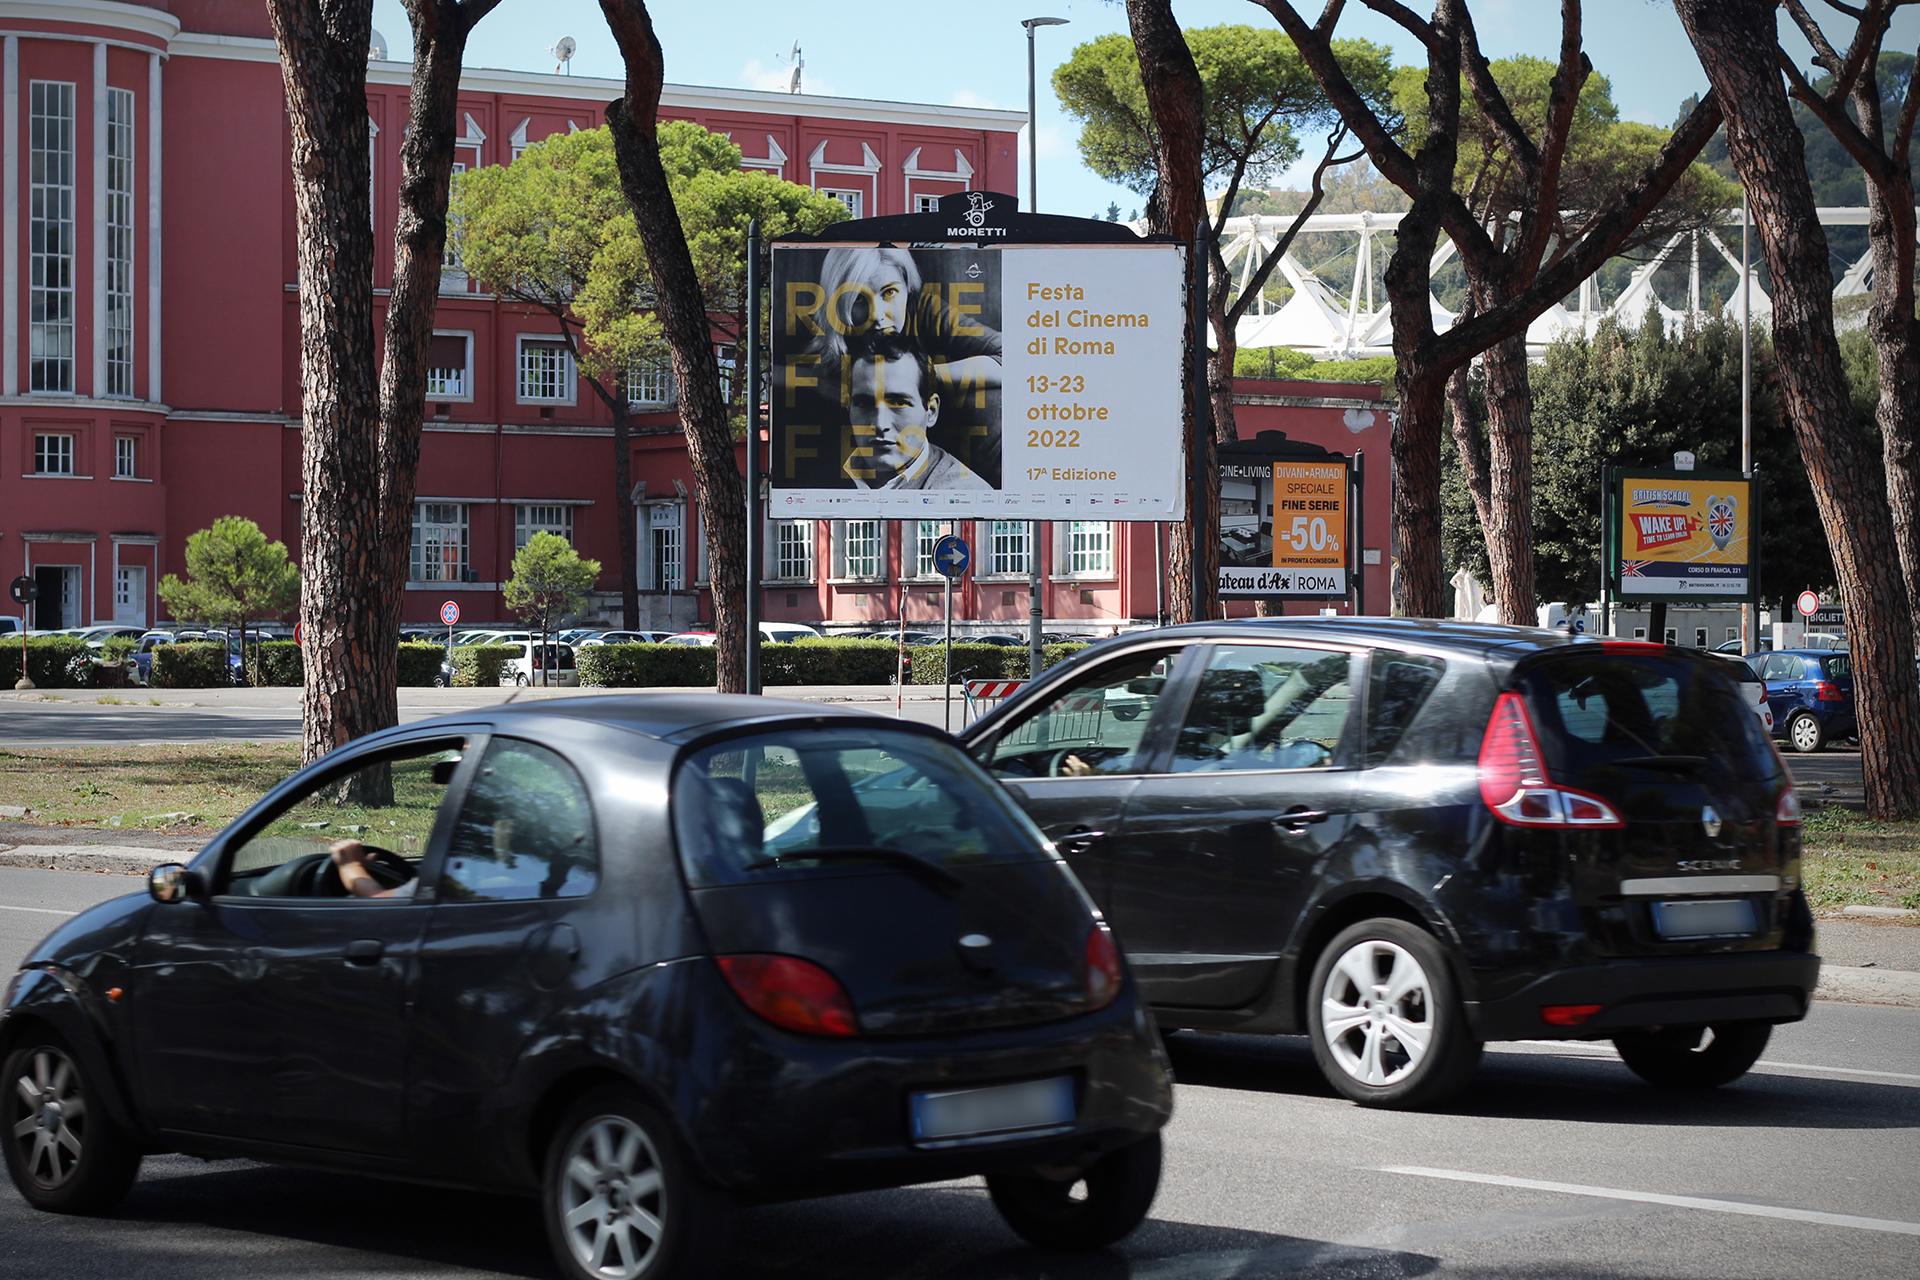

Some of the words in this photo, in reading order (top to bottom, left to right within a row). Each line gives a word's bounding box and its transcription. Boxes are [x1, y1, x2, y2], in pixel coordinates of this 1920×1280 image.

[947, 227, 1007, 237] MORETTI
[1027, 281, 1085, 303] Festa
[785, 281, 985, 338] ROME
[1027, 309, 1061, 329] del
[1066, 309, 1150, 329] Cinema
[1027, 335, 1047, 356] di
[1054, 336, 1116, 356] Roma
[1026, 375, 1086, 394] 13-23
[1026, 401, 1110, 422] ottobre
[1027, 429, 1081, 449] 2022
[1052, 467, 1118, 482] Edizione
[1287, 483, 1335, 495] SPECIALE
[1632, 489, 1662, 502] BRITISH
[1662, 490, 1690, 502] SCHOOL
[1282, 500, 1306, 511] FINE
[1308, 501, 1340, 512] SERIE
[1281, 516, 1339, 552] -50%
[1638, 515, 1672, 535] WAKE
[1673, 514, 1687, 530] UP!
[1309, 557, 1339, 565] CONSEGNA
[1298, 576, 1337, 591] ROMA
